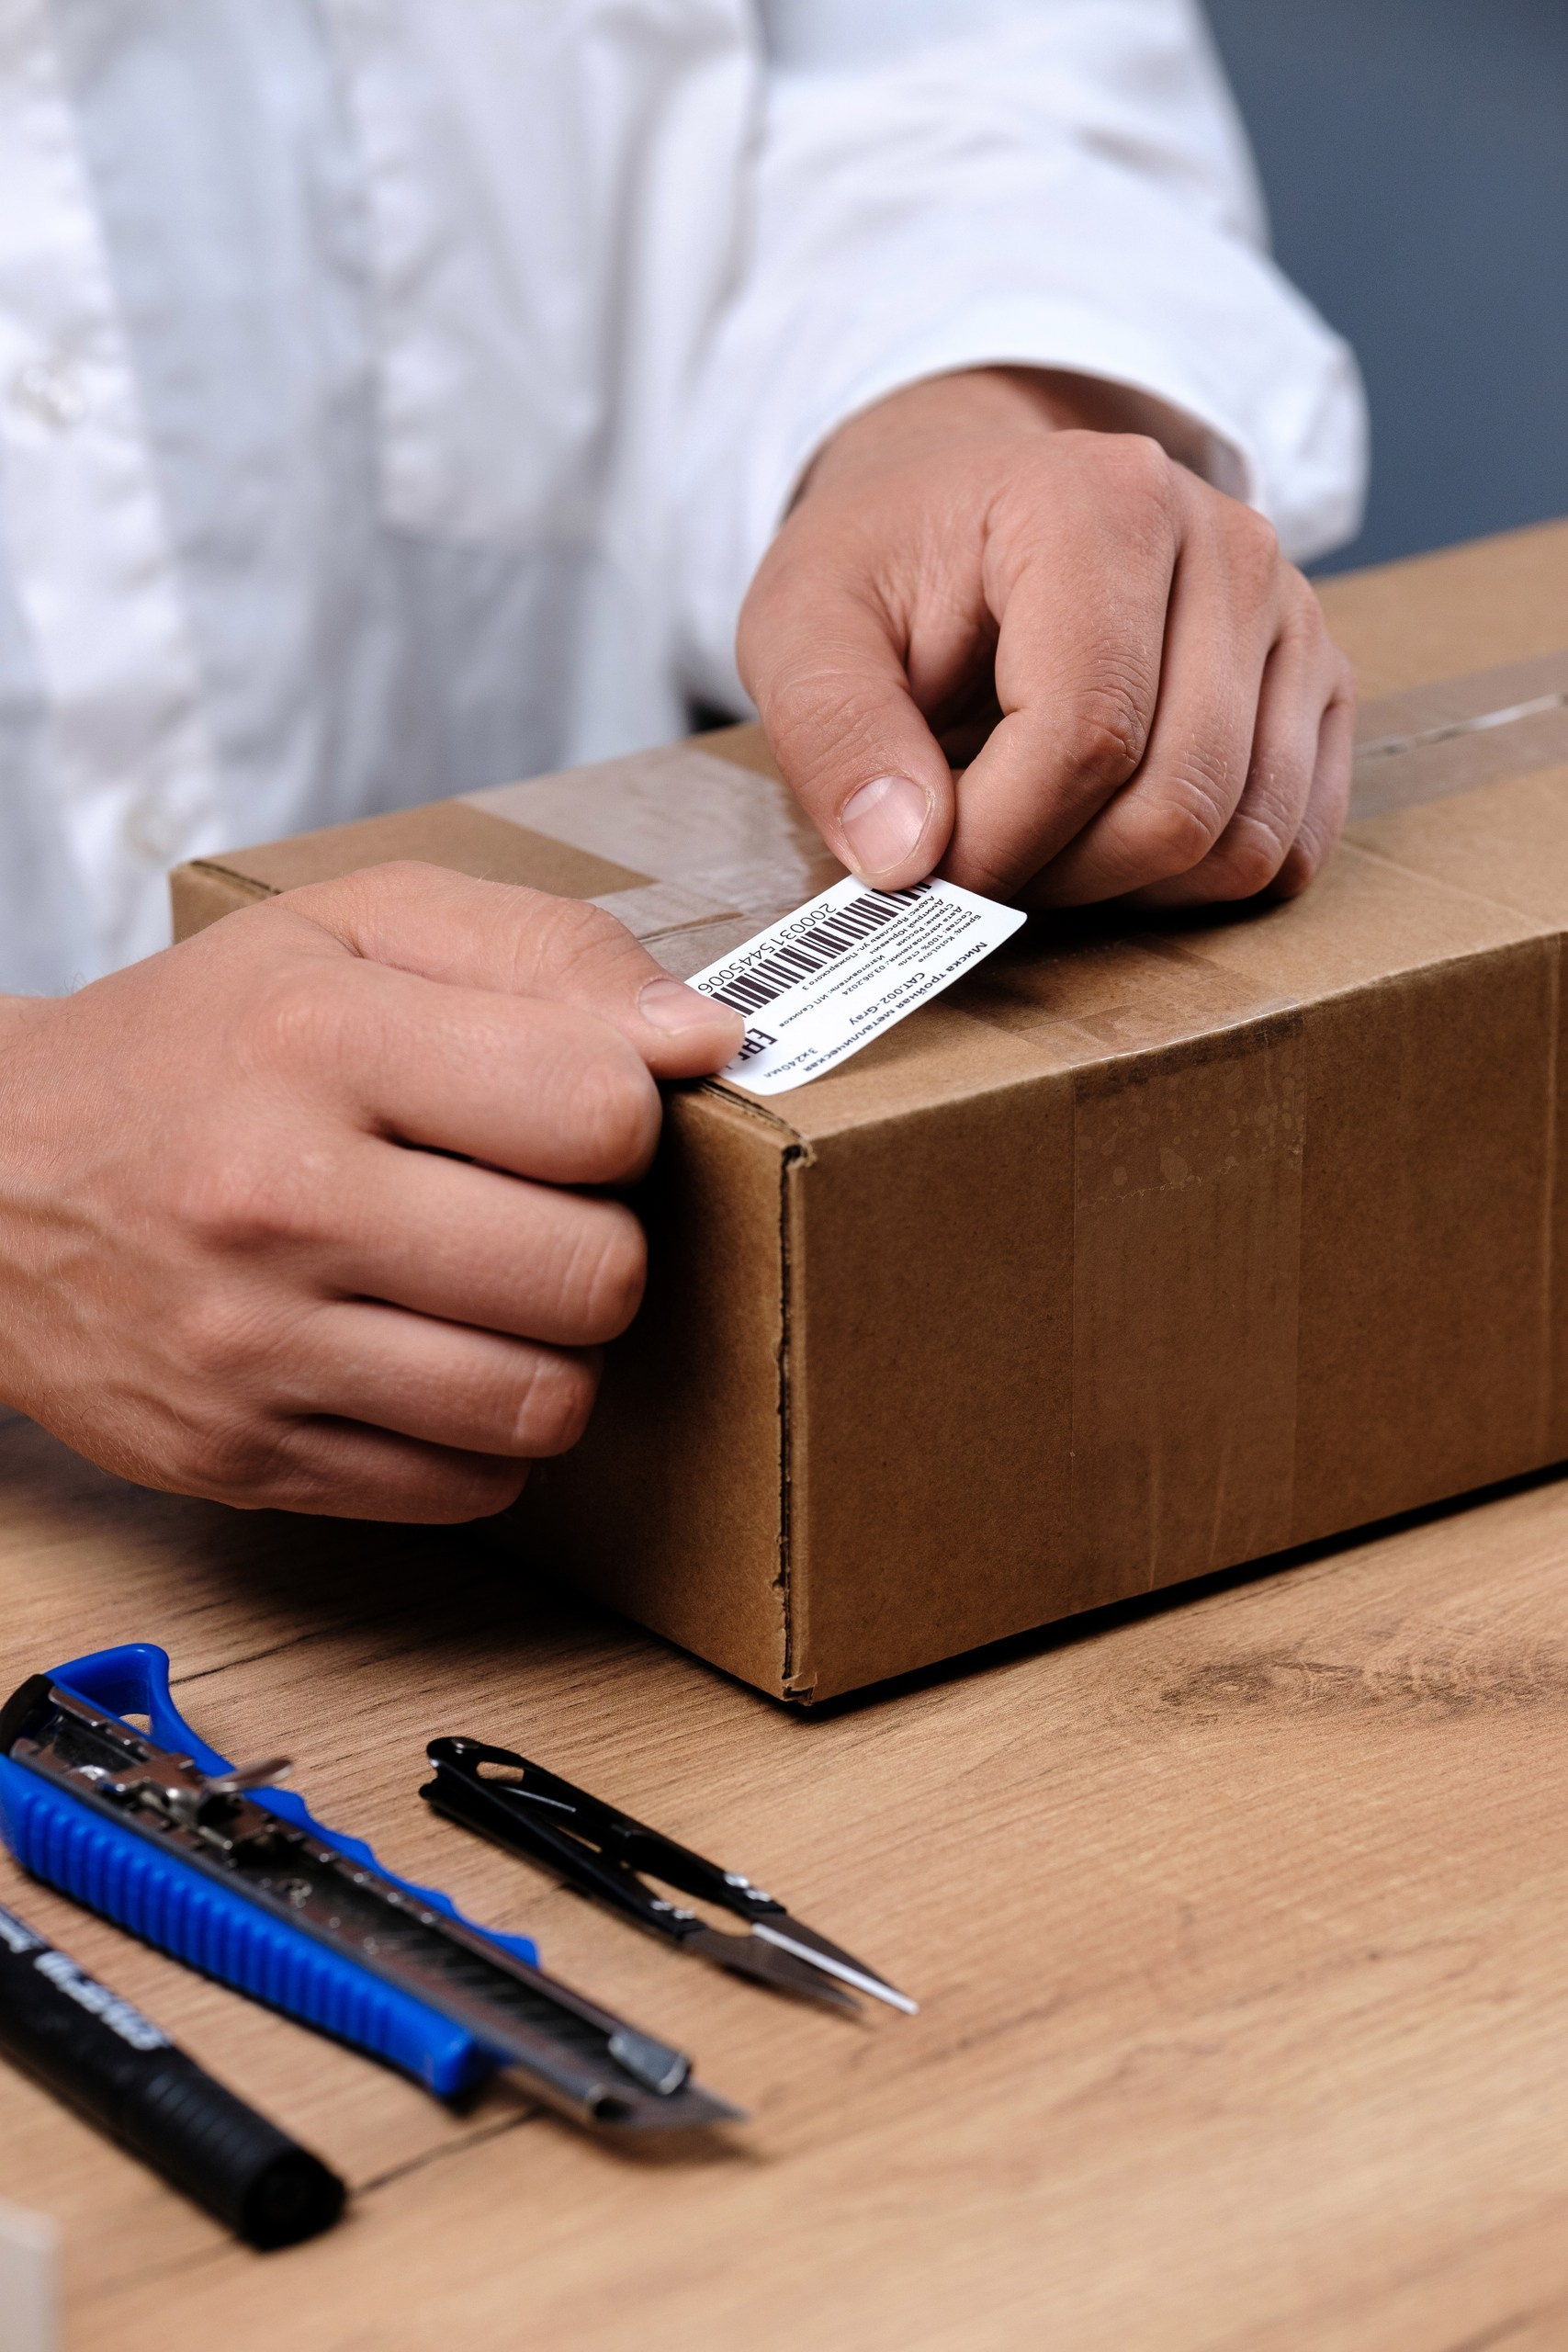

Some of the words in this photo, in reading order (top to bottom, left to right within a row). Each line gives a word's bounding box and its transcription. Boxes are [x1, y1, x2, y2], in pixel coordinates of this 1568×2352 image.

[907, 899, 944, 929] Дмитрий
[908, 895, 935, 917] Адрес:
[923, 903, 954, 927] Страна:
[942, 905, 963, 922] Дата
[942, 910, 973, 933] Состав:
[953, 914, 982, 935] Бренд:
[697, 902, 837, 994] 2000315445006
[856, 942, 871, 952] ул.
[869, 928, 908, 955] Юрьевич
[896, 926, 926, 947] Россия
[920, 934, 943, 950] 100%
[808, 952, 859, 986] Пожарского
[897, 950, 920, 967] сталь
[945, 942, 988, 972] Миска
[827, 955, 886, 994] Изготовитель:
[841, 965, 886, 996] 03.06.2024
[813, 993, 829, 1005] ИП
[849, 972, 926, 1025] CAT.002-Gray
[895, 973, 947, 1009] тройная
[779, 1003, 815, 1028] Салихов
[803, 1009, 896, 1072] металлическая
